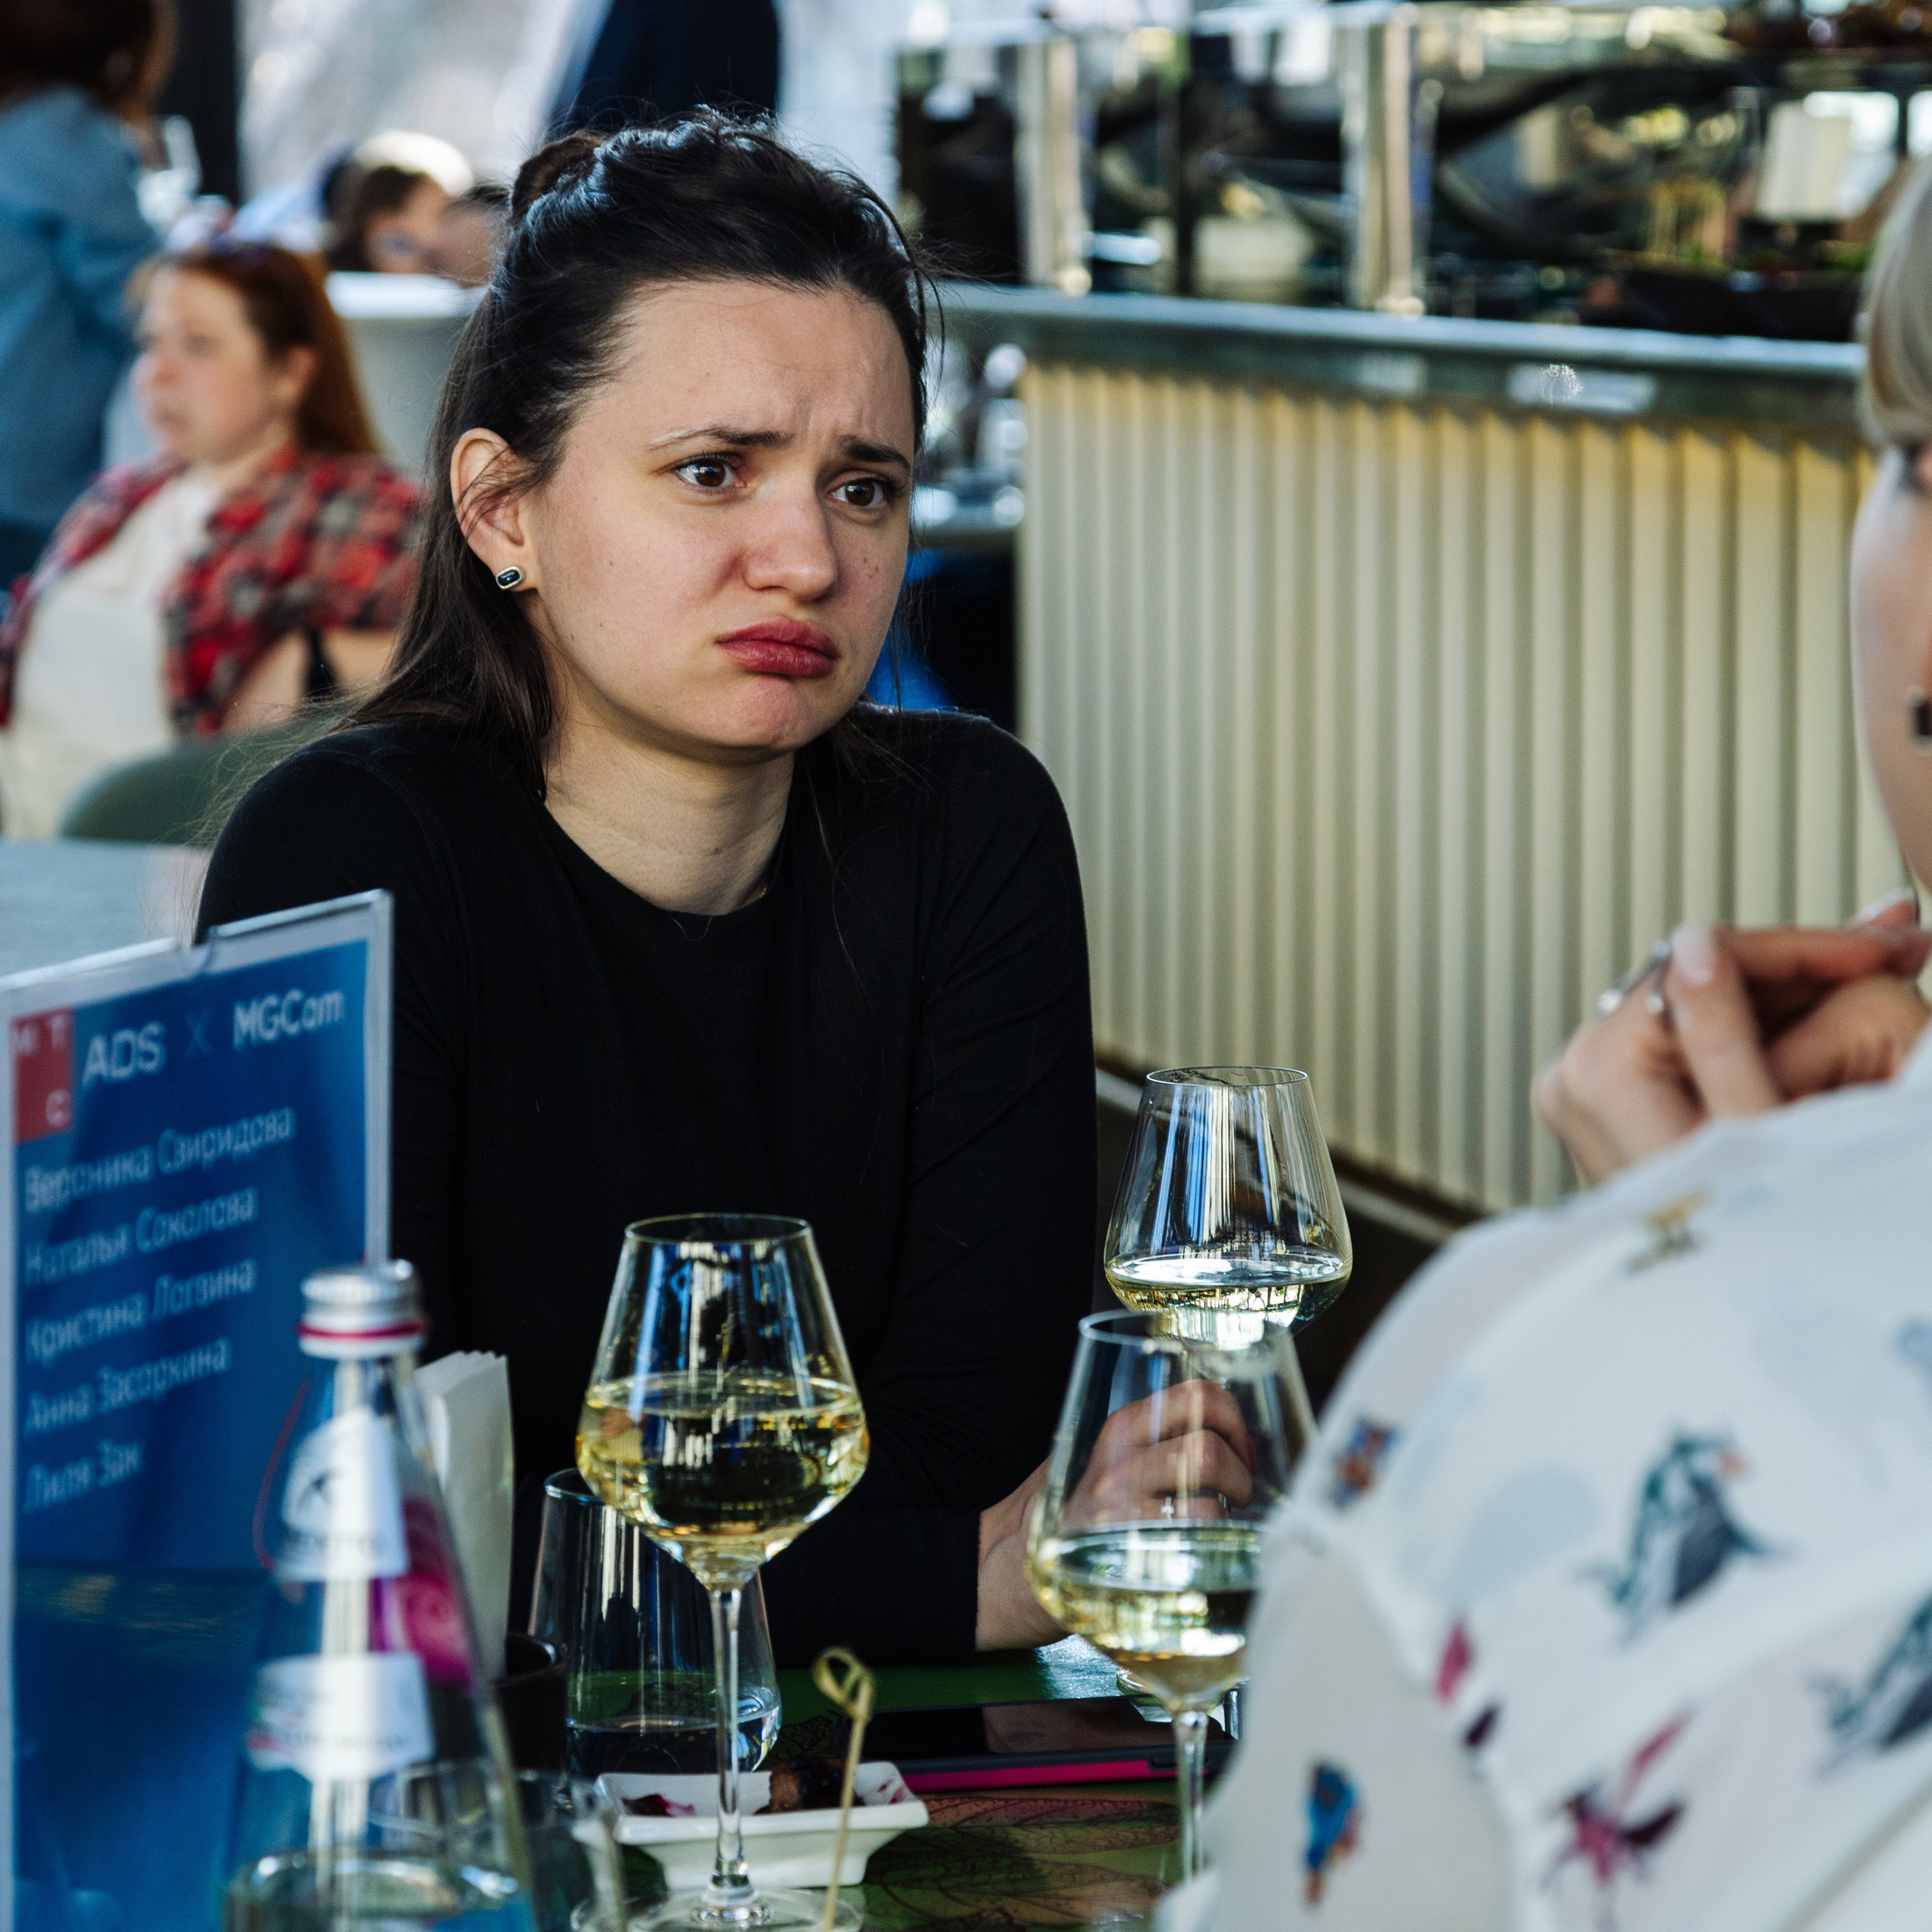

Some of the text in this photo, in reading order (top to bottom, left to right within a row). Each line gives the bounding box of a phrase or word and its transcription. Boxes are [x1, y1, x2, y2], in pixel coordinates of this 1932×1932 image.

[82, 1023, 165, 1085] ADS
[233, 989, 344, 1048] MGCom
[26, 1108, 294, 1211] Вероника Свиридова
[26, 1188, 257, 1284] Наталья Соколова
[26, 1294, 148, 1365] Кристина
